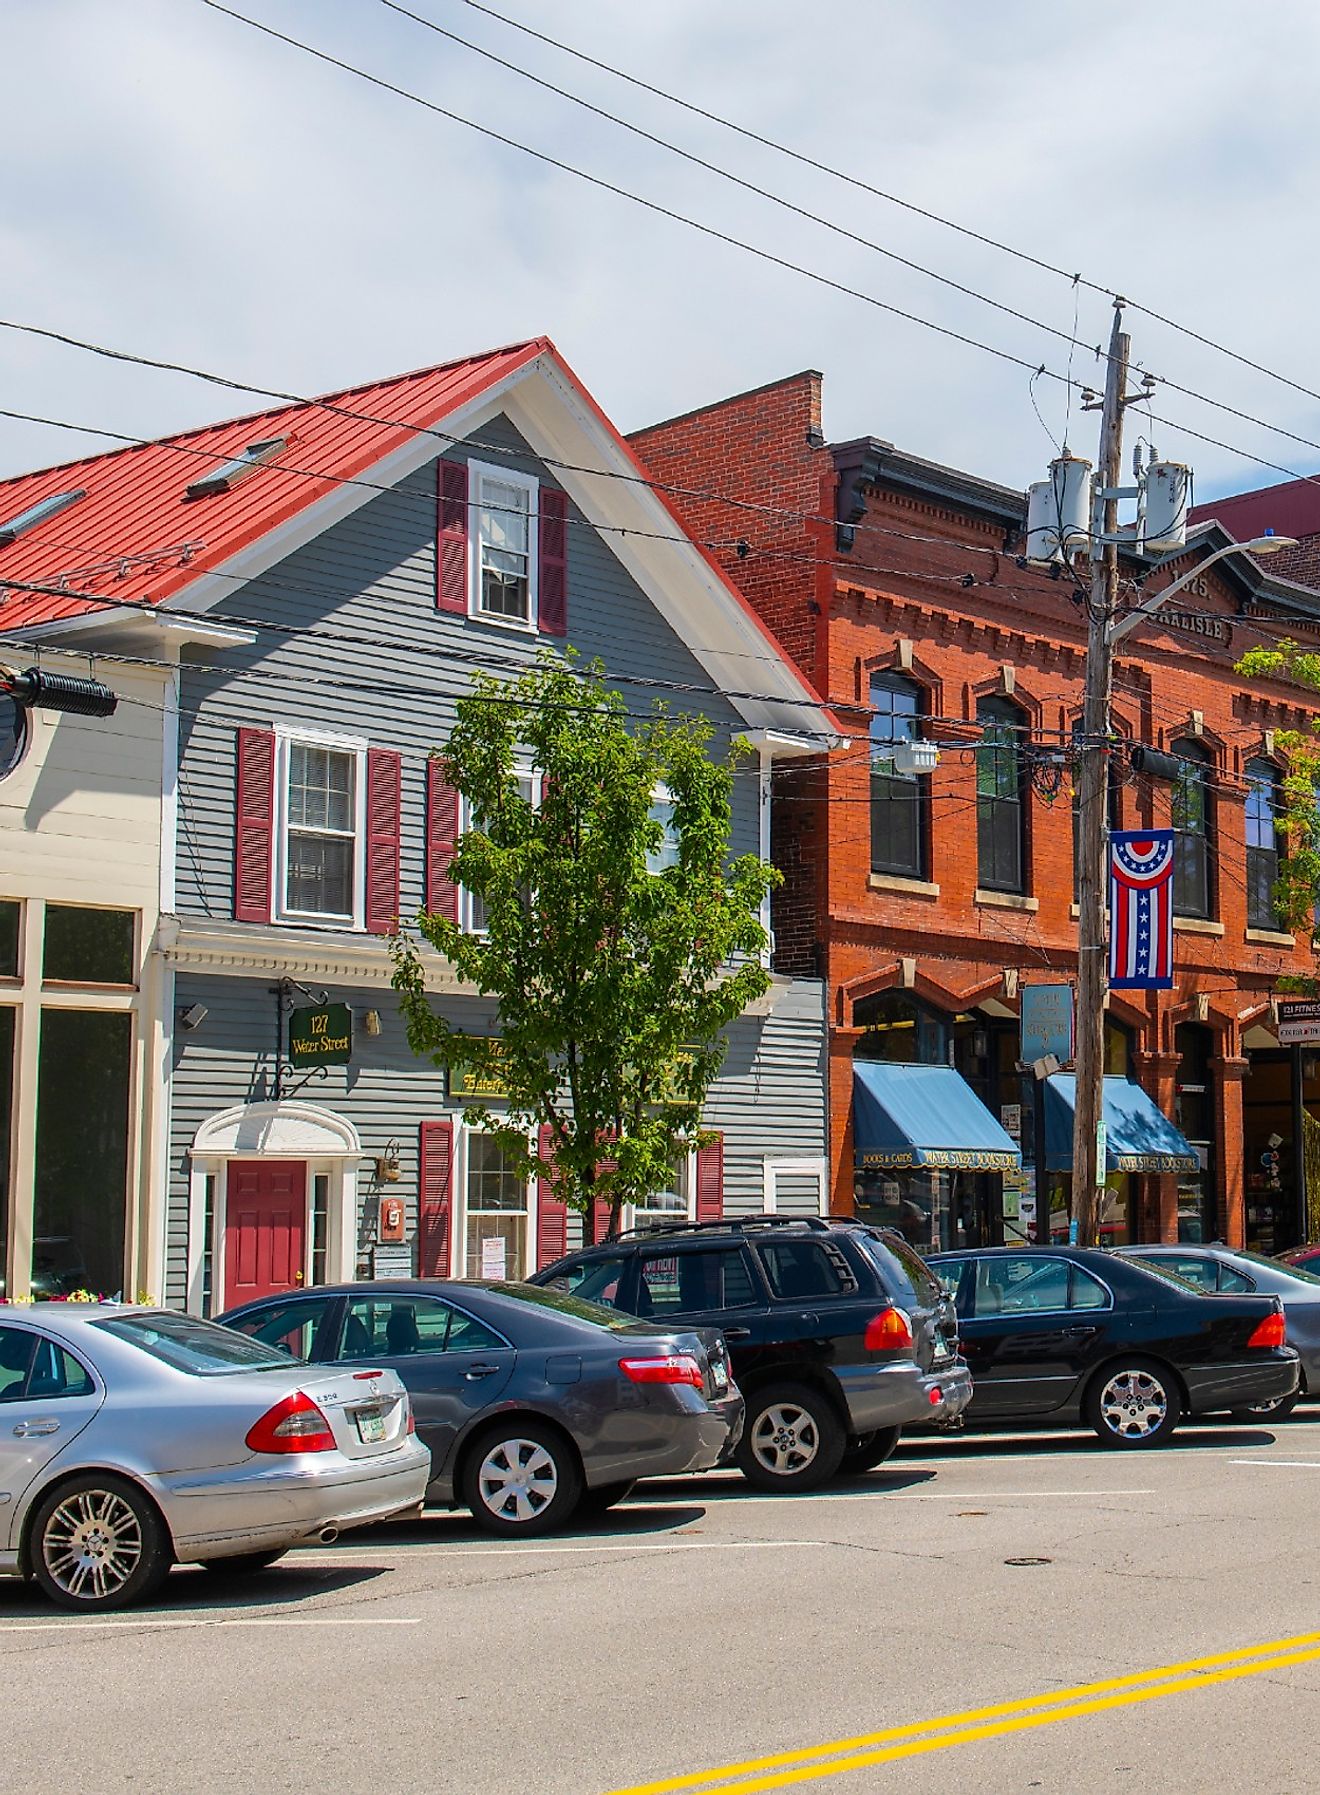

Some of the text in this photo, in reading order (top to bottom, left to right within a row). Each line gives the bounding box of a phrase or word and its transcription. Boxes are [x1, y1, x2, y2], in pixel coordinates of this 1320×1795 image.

[311, 1014, 329, 1034] 127
[292, 1035, 349, 1054] Water Street
[863, 1154, 884, 1164] BOOKS
[891, 1152, 912, 1164] CARDS
[925, 1150, 1017, 1167] WATER STREET BOOKSTORE
[1138, 1155, 1160, 1169] STREET
[1161, 1156, 1196, 1170] BOOKSTORE
